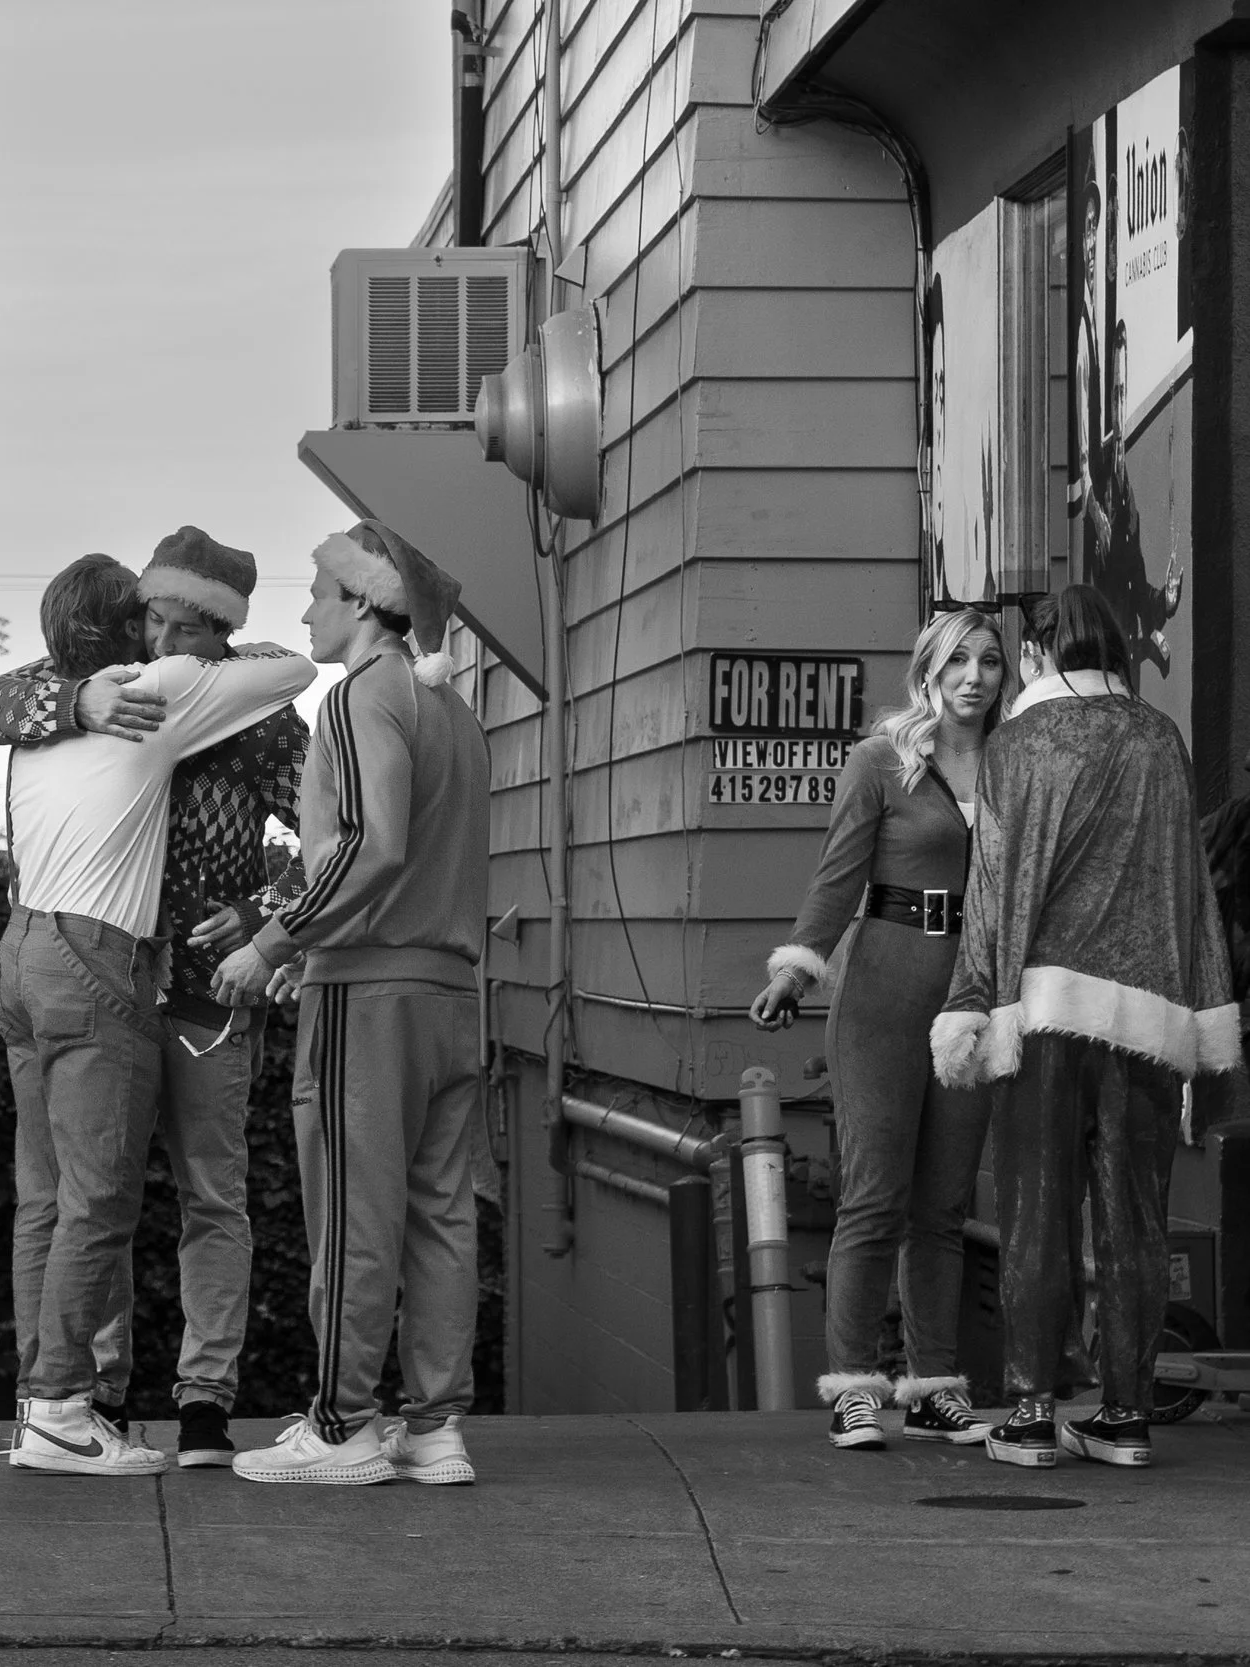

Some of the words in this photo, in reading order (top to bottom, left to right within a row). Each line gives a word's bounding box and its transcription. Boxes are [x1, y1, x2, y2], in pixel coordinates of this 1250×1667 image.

[1126, 136, 1167, 240] Union
[1125, 249, 1152, 287] CANNABIS
[1153, 240, 1168, 272] CLUB
[714, 658, 769, 727] FOR
[778, 661, 858, 730] RENT
[716, 740, 768, 768] VIEW
[711, 774, 836, 804] 41529789
